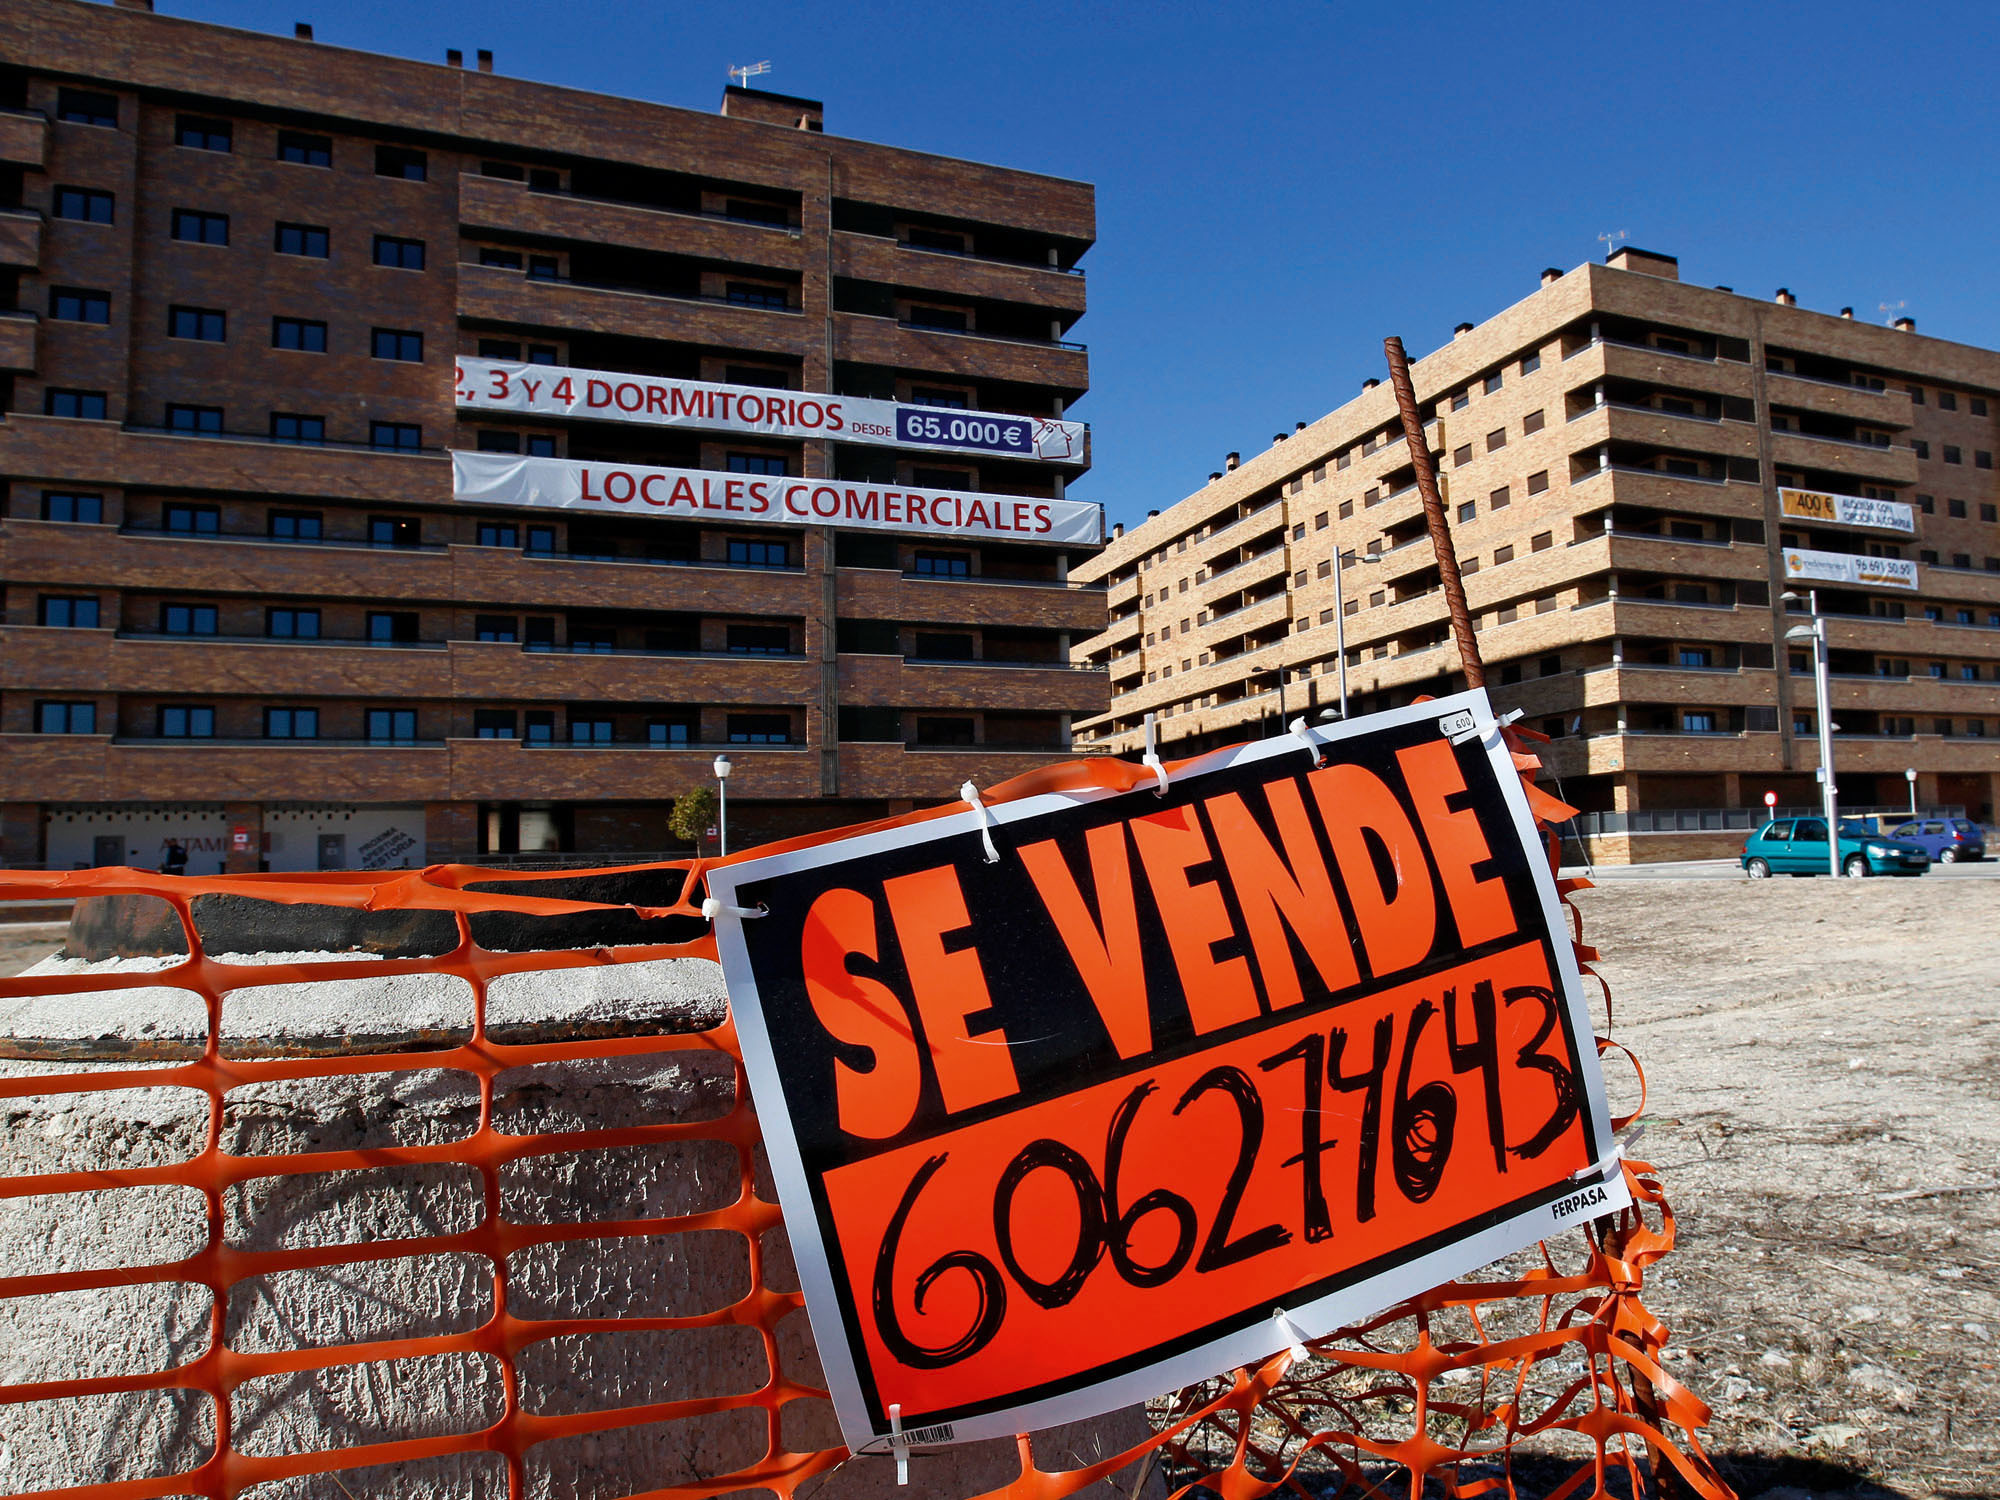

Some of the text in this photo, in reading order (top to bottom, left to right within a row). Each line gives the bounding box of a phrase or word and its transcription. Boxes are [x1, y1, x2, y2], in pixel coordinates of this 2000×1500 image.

[488, 369, 509, 400] 3
[521, 378, 542, 402] Y
[551, 376, 575, 406] 4
[586, 379, 844, 431] DORMITORIOS
[852, 422, 892, 437] DESDE
[906, 415, 1022, 446] 65.000€
[581, 469, 1052, 533] LOCALES COMERCIALES
[1797, 494, 1833, 513] 400 €
[1856, 559, 1867, 571] 96
[1869, 560, 1885, 573] 691
[1443, 723, 1449, 732] €
[801, 738, 1518, 1140] SE VENDE
[873, 979, 1579, 1371] 606274643
[1552, 1187, 1608, 1220] FERPASA
